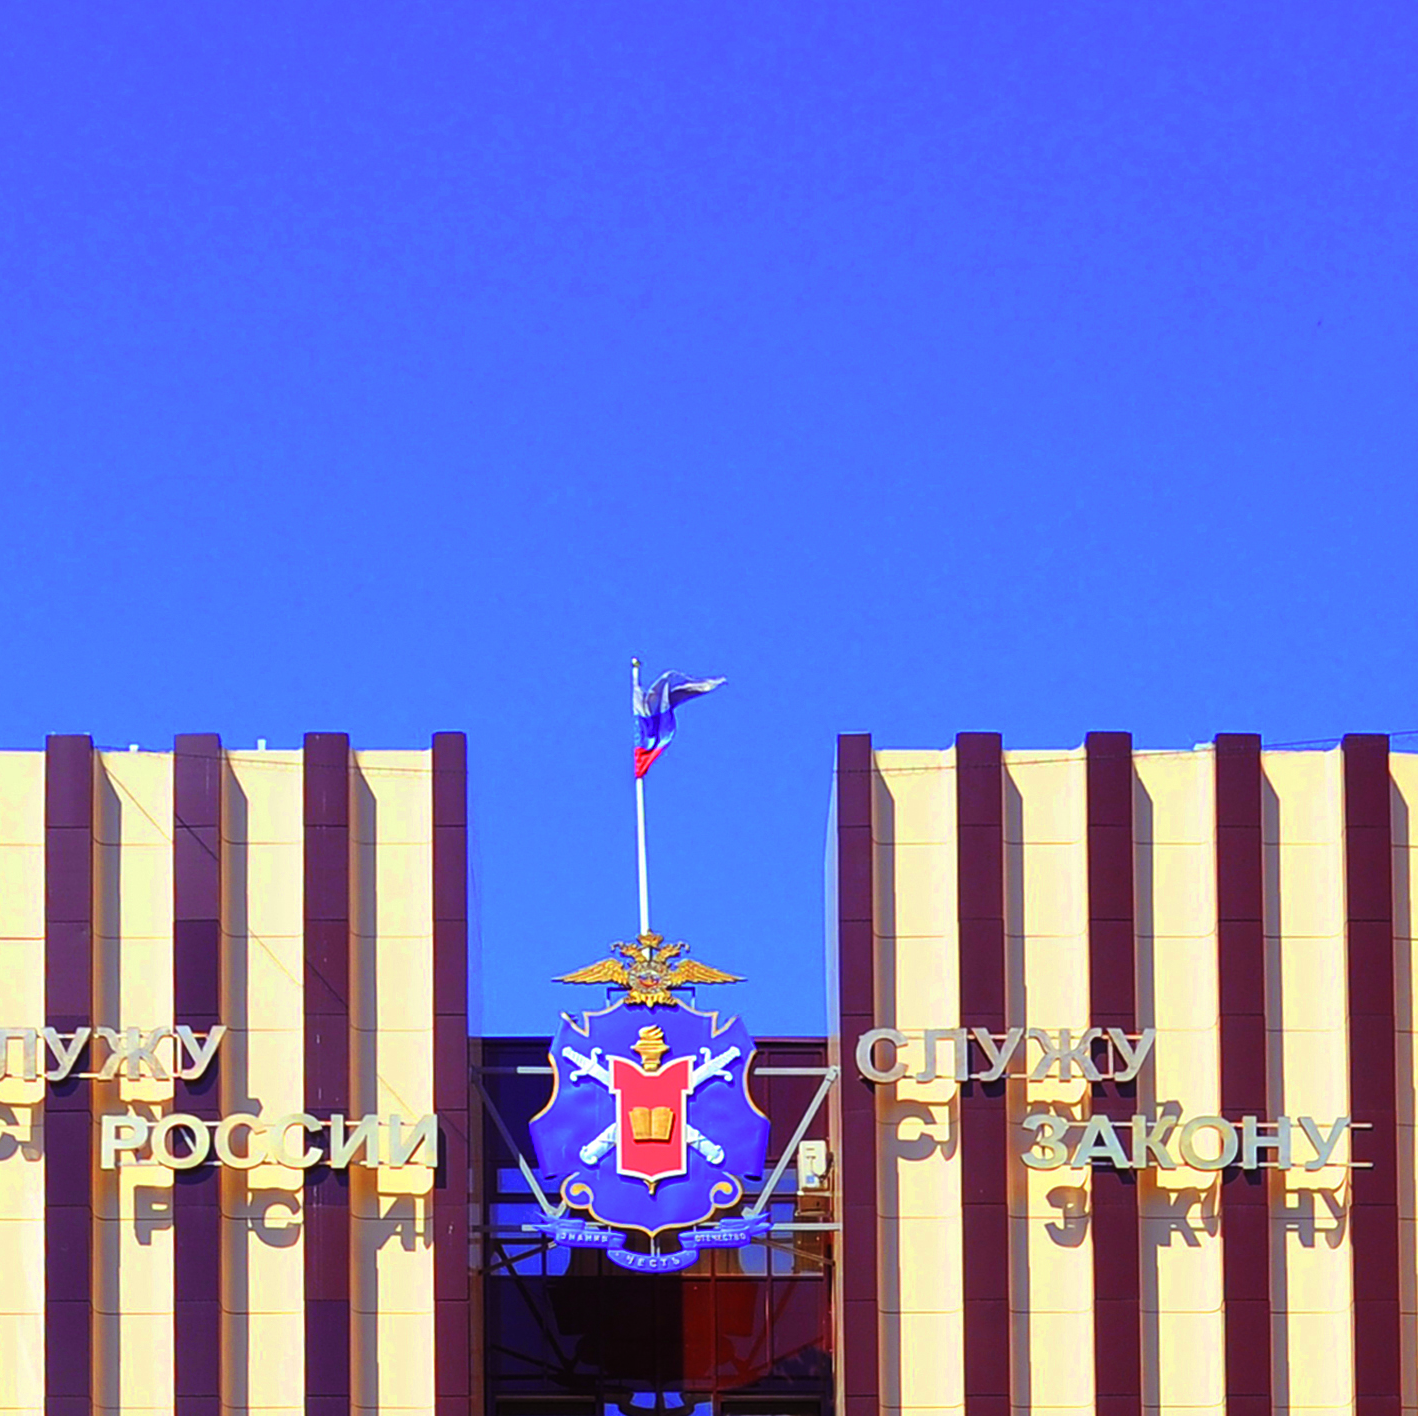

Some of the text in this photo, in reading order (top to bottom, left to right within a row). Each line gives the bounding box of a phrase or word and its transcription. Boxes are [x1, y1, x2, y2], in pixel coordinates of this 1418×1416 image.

[856, 1027, 1156, 1083] СЛУЖУ
[100, 1113, 438, 1170] РОССИИ
[1021, 1114, 1350, 1170] ЗАКОНУ
[626, 1255, 681, 1269] ЧЕСТЬ
